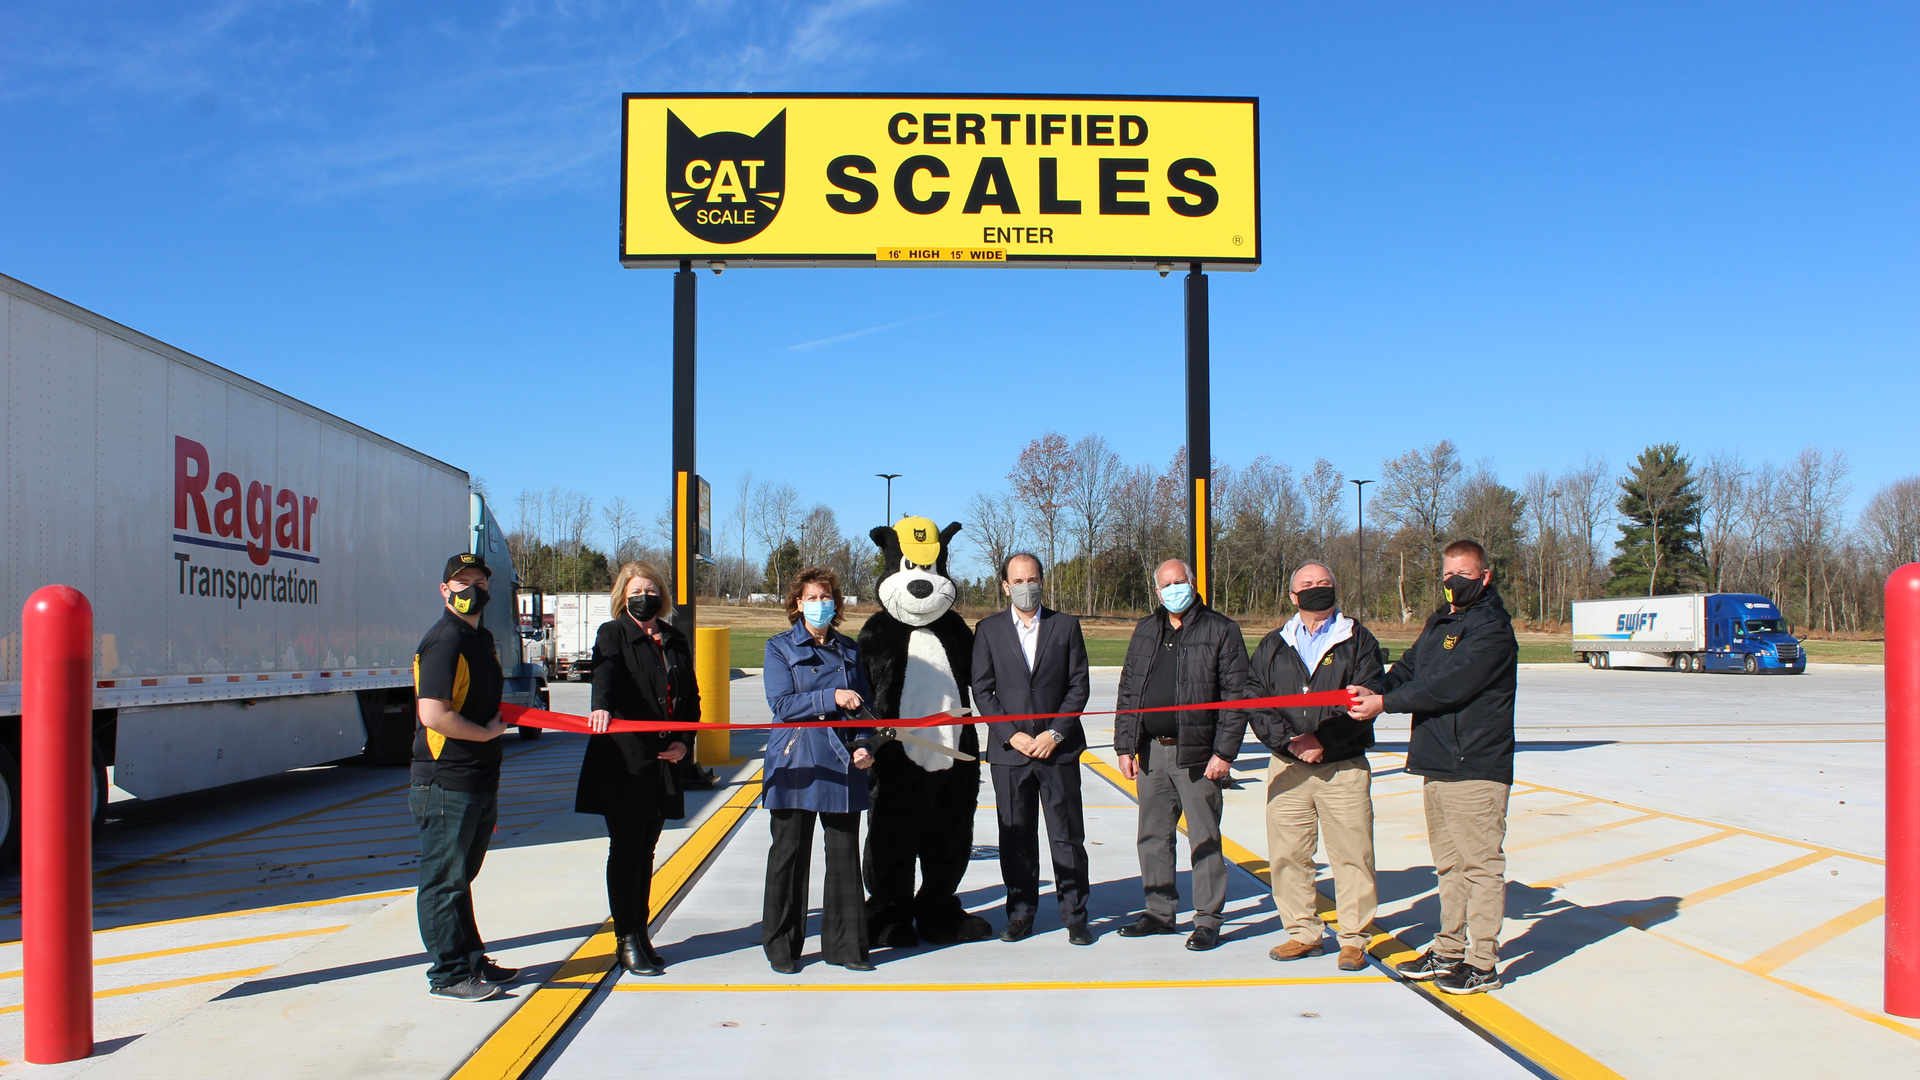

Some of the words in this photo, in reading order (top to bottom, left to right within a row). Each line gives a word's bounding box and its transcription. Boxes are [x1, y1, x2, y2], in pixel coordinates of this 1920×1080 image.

[887, 111, 1149, 147] CERTIFIED
[684, 159, 765, 203] CAT
[825, 154, 1220, 217] SCALES
[696, 208, 756, 225] SCALE
[983, 226, 1054, 244] ENTER
[909, 249, 940, 259] HIGH
[969, 250, 1003, 260] WIDE
[174, 434, 319, 567] Ragar
[174, 551, 319, 610] Transportation
[1616, 613, 1657, 632] SWIFT
